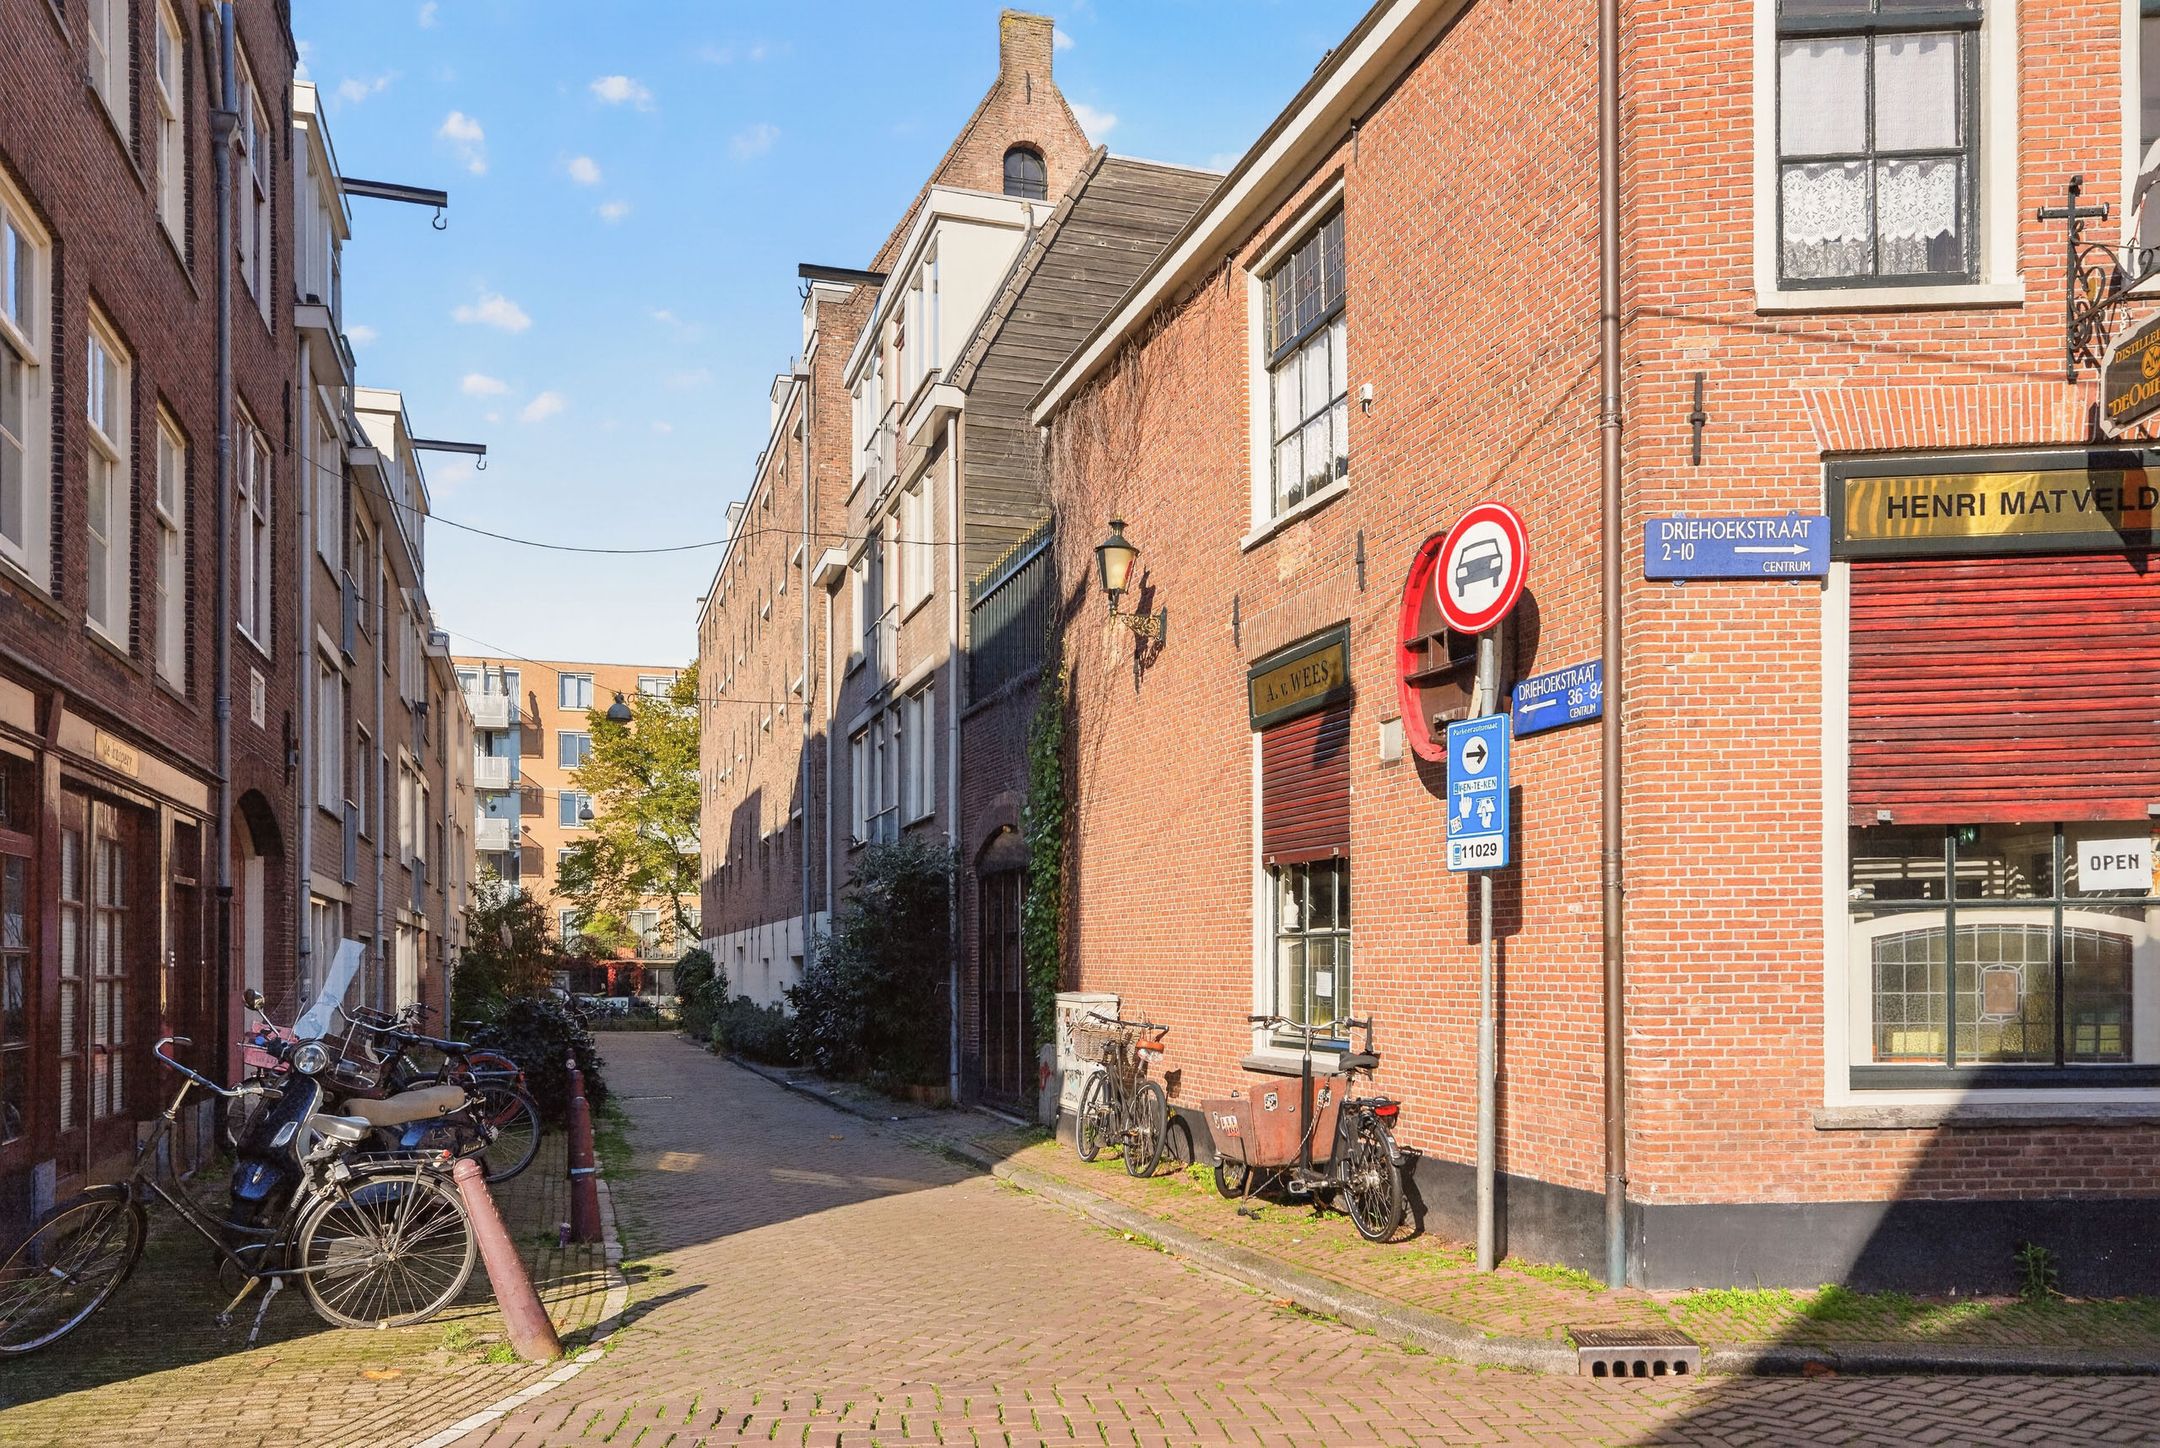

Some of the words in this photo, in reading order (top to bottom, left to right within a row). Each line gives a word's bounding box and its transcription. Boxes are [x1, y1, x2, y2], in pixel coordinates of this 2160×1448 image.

[1887, 493, 1985, 519] HENRI
[2000, 486, 2159, 515] MATVELD
[1661, 520, 1812, 540] DRIEHOEKSTRAAT
[1662, 543, 1695, 561] 2-10
[1762, 561, 1811, 572] CENTRUM
[1291, 660, 1329, 693] WEES
[1518, 663, 1597, 701] DRIEHOEKSTRAAT
[1569, 703, 1596, 719] CENTRUM
[1462, 842, 1498, 859] 11029
[2090, 854, 2140, 871] OPEN
